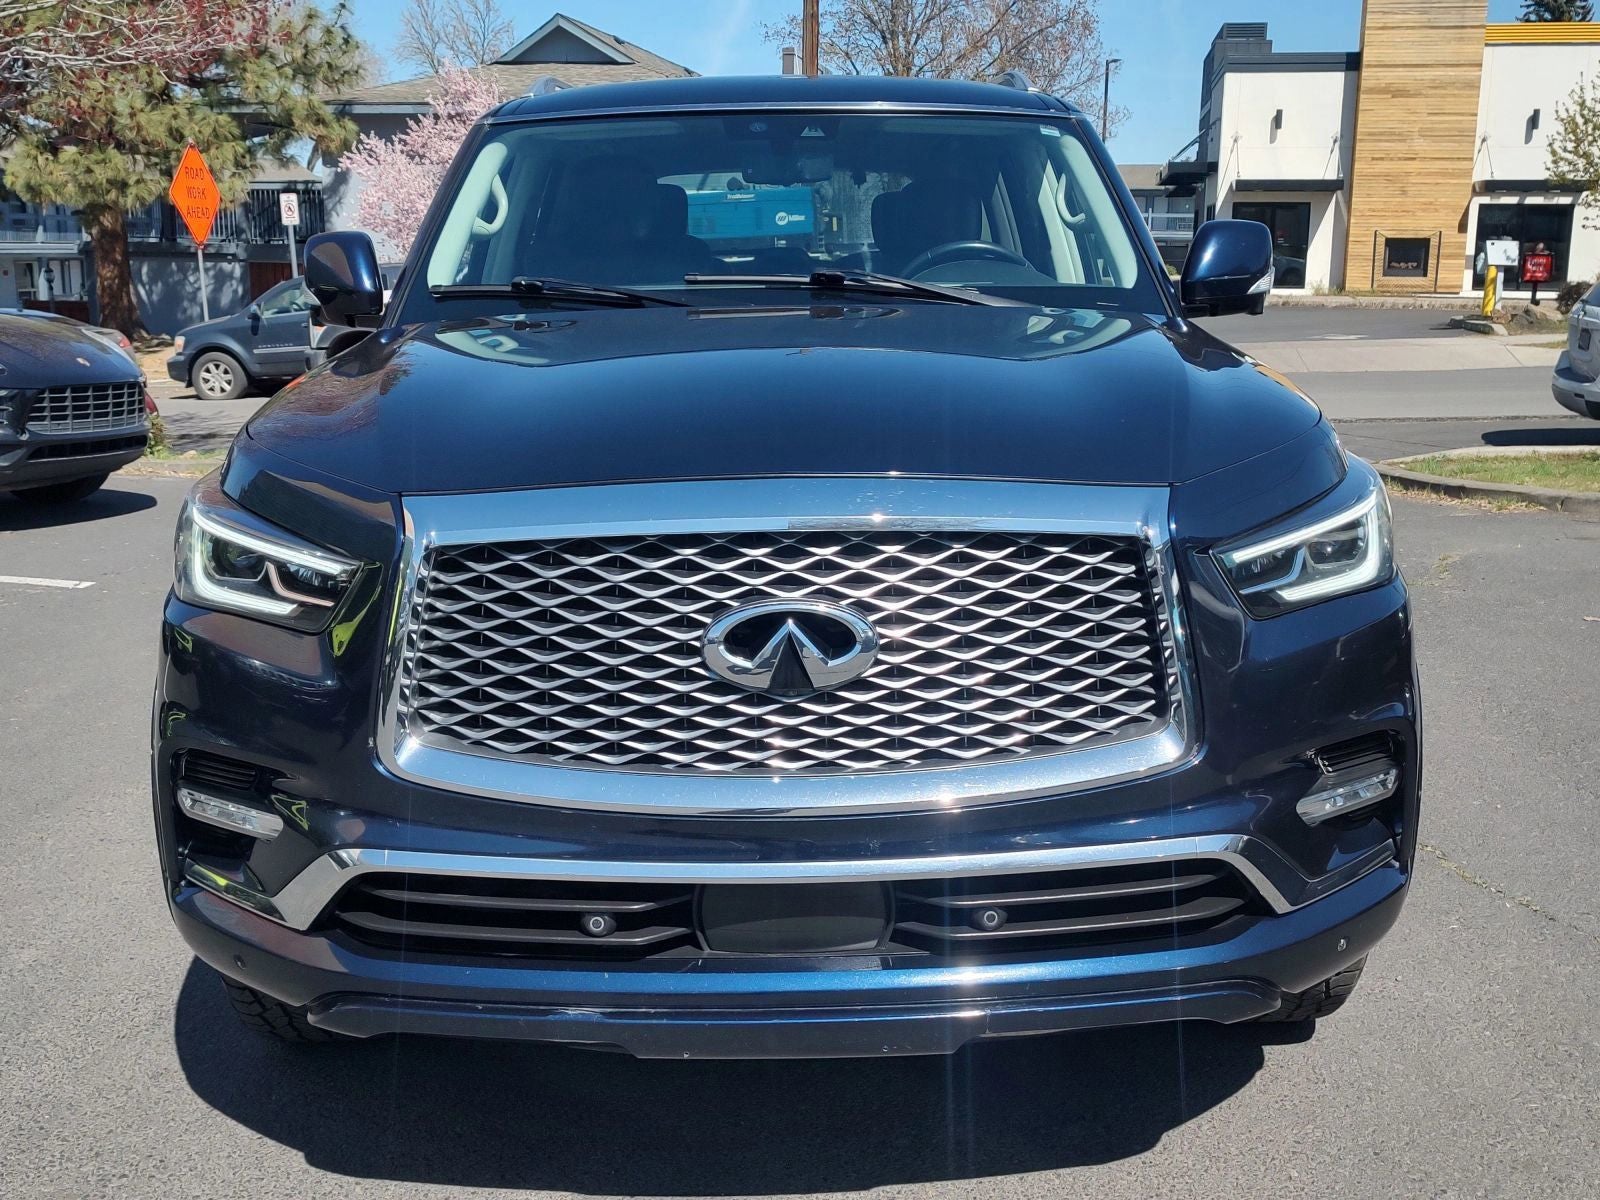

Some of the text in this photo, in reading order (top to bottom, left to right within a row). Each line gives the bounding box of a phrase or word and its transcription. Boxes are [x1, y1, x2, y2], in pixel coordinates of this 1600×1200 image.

[185, 166, 205, 180] ROAD
[186, 185, 207, 200] WORK
[186, 205, 210, 219] AHEAD
